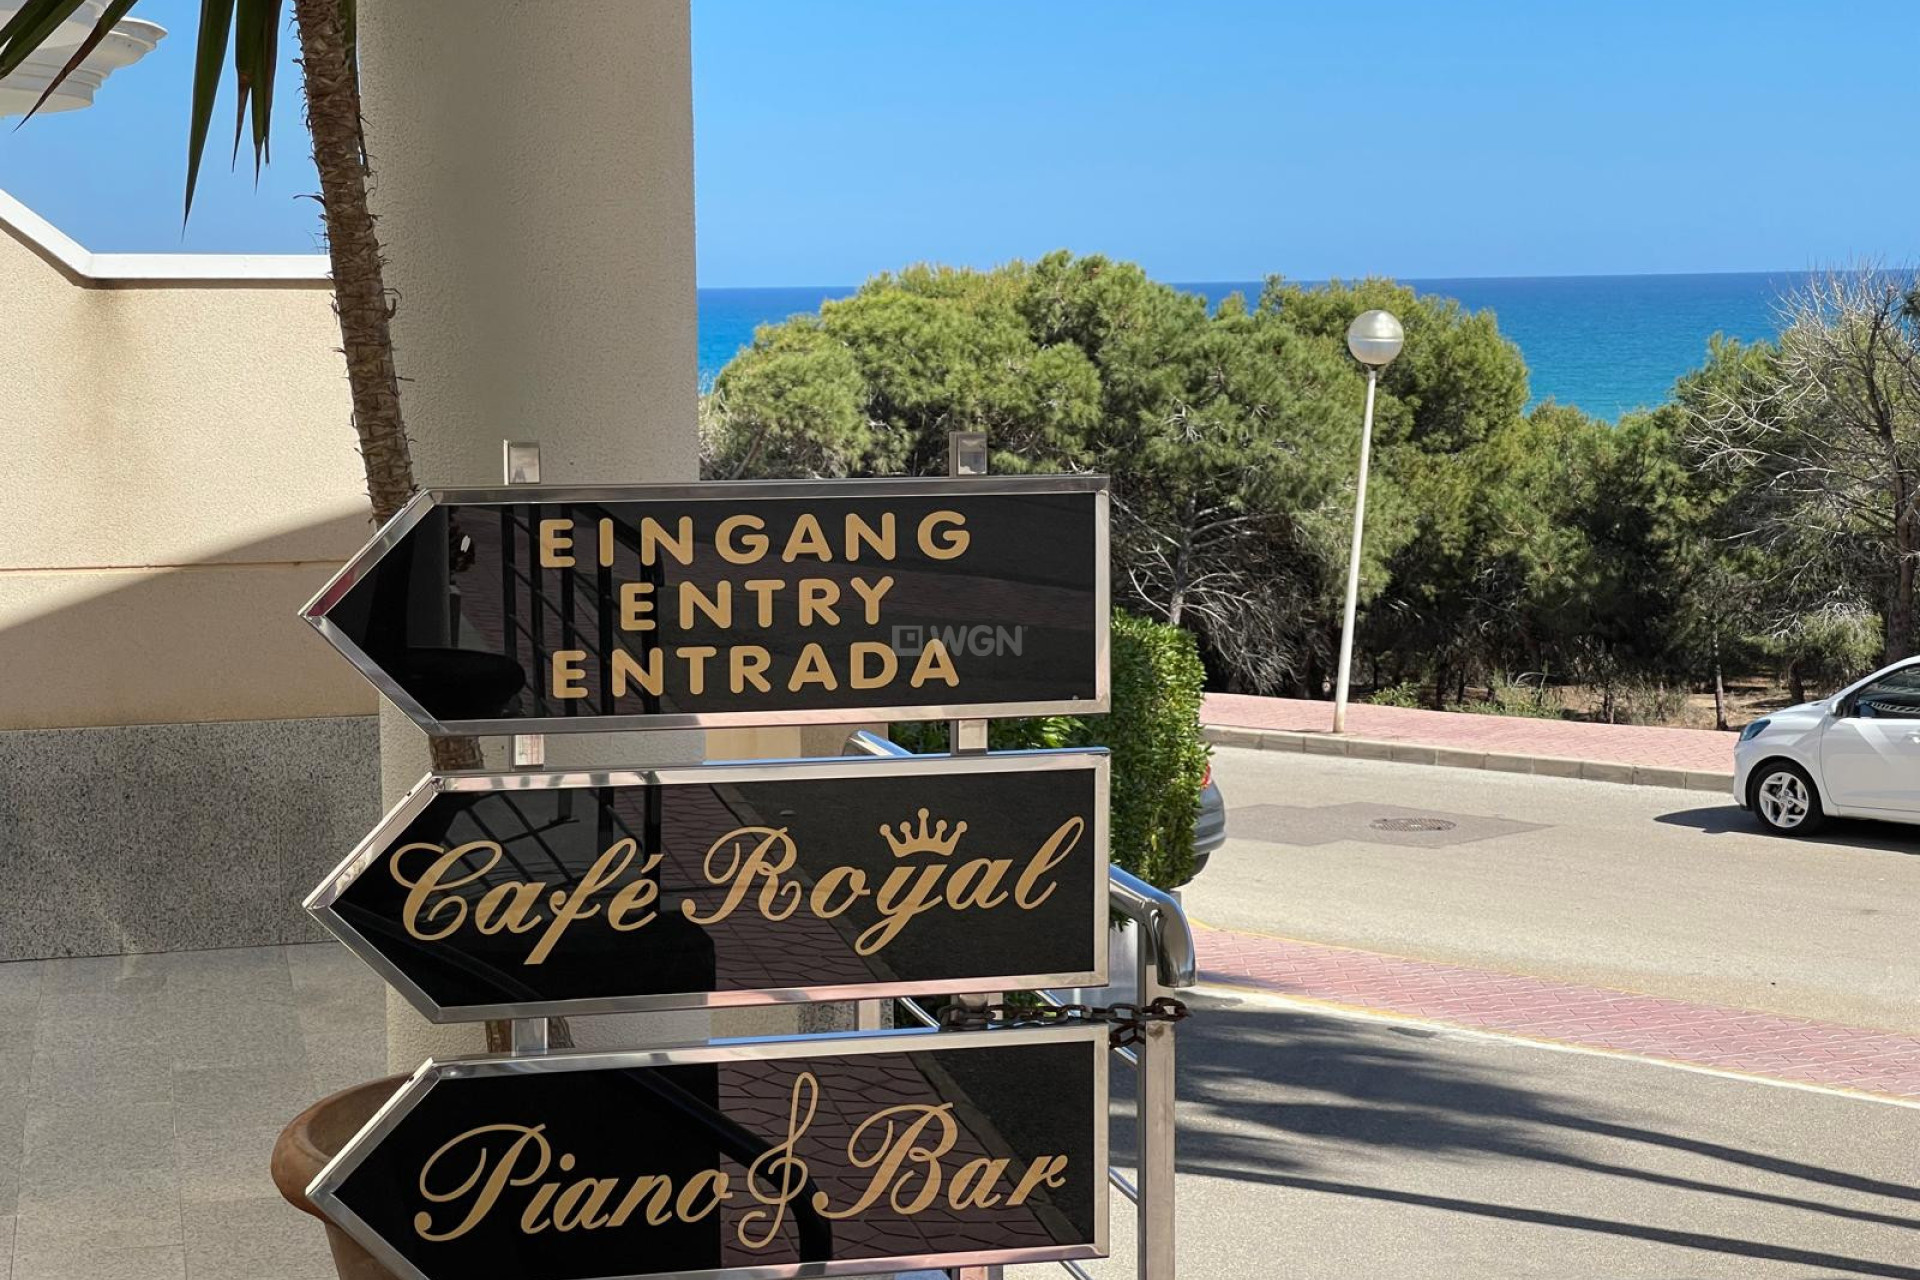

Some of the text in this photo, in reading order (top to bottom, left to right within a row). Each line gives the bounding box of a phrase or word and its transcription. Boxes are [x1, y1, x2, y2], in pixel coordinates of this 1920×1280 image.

[539, 510, 970, 568] EINGANG
[619, 576, 894, 632] ENTRY
[551, 639, 961, 700] ENTRADA
[389, 814, 1086, 966] Café Royal
[413, 1103, 1068, 1242] Piano Bar
